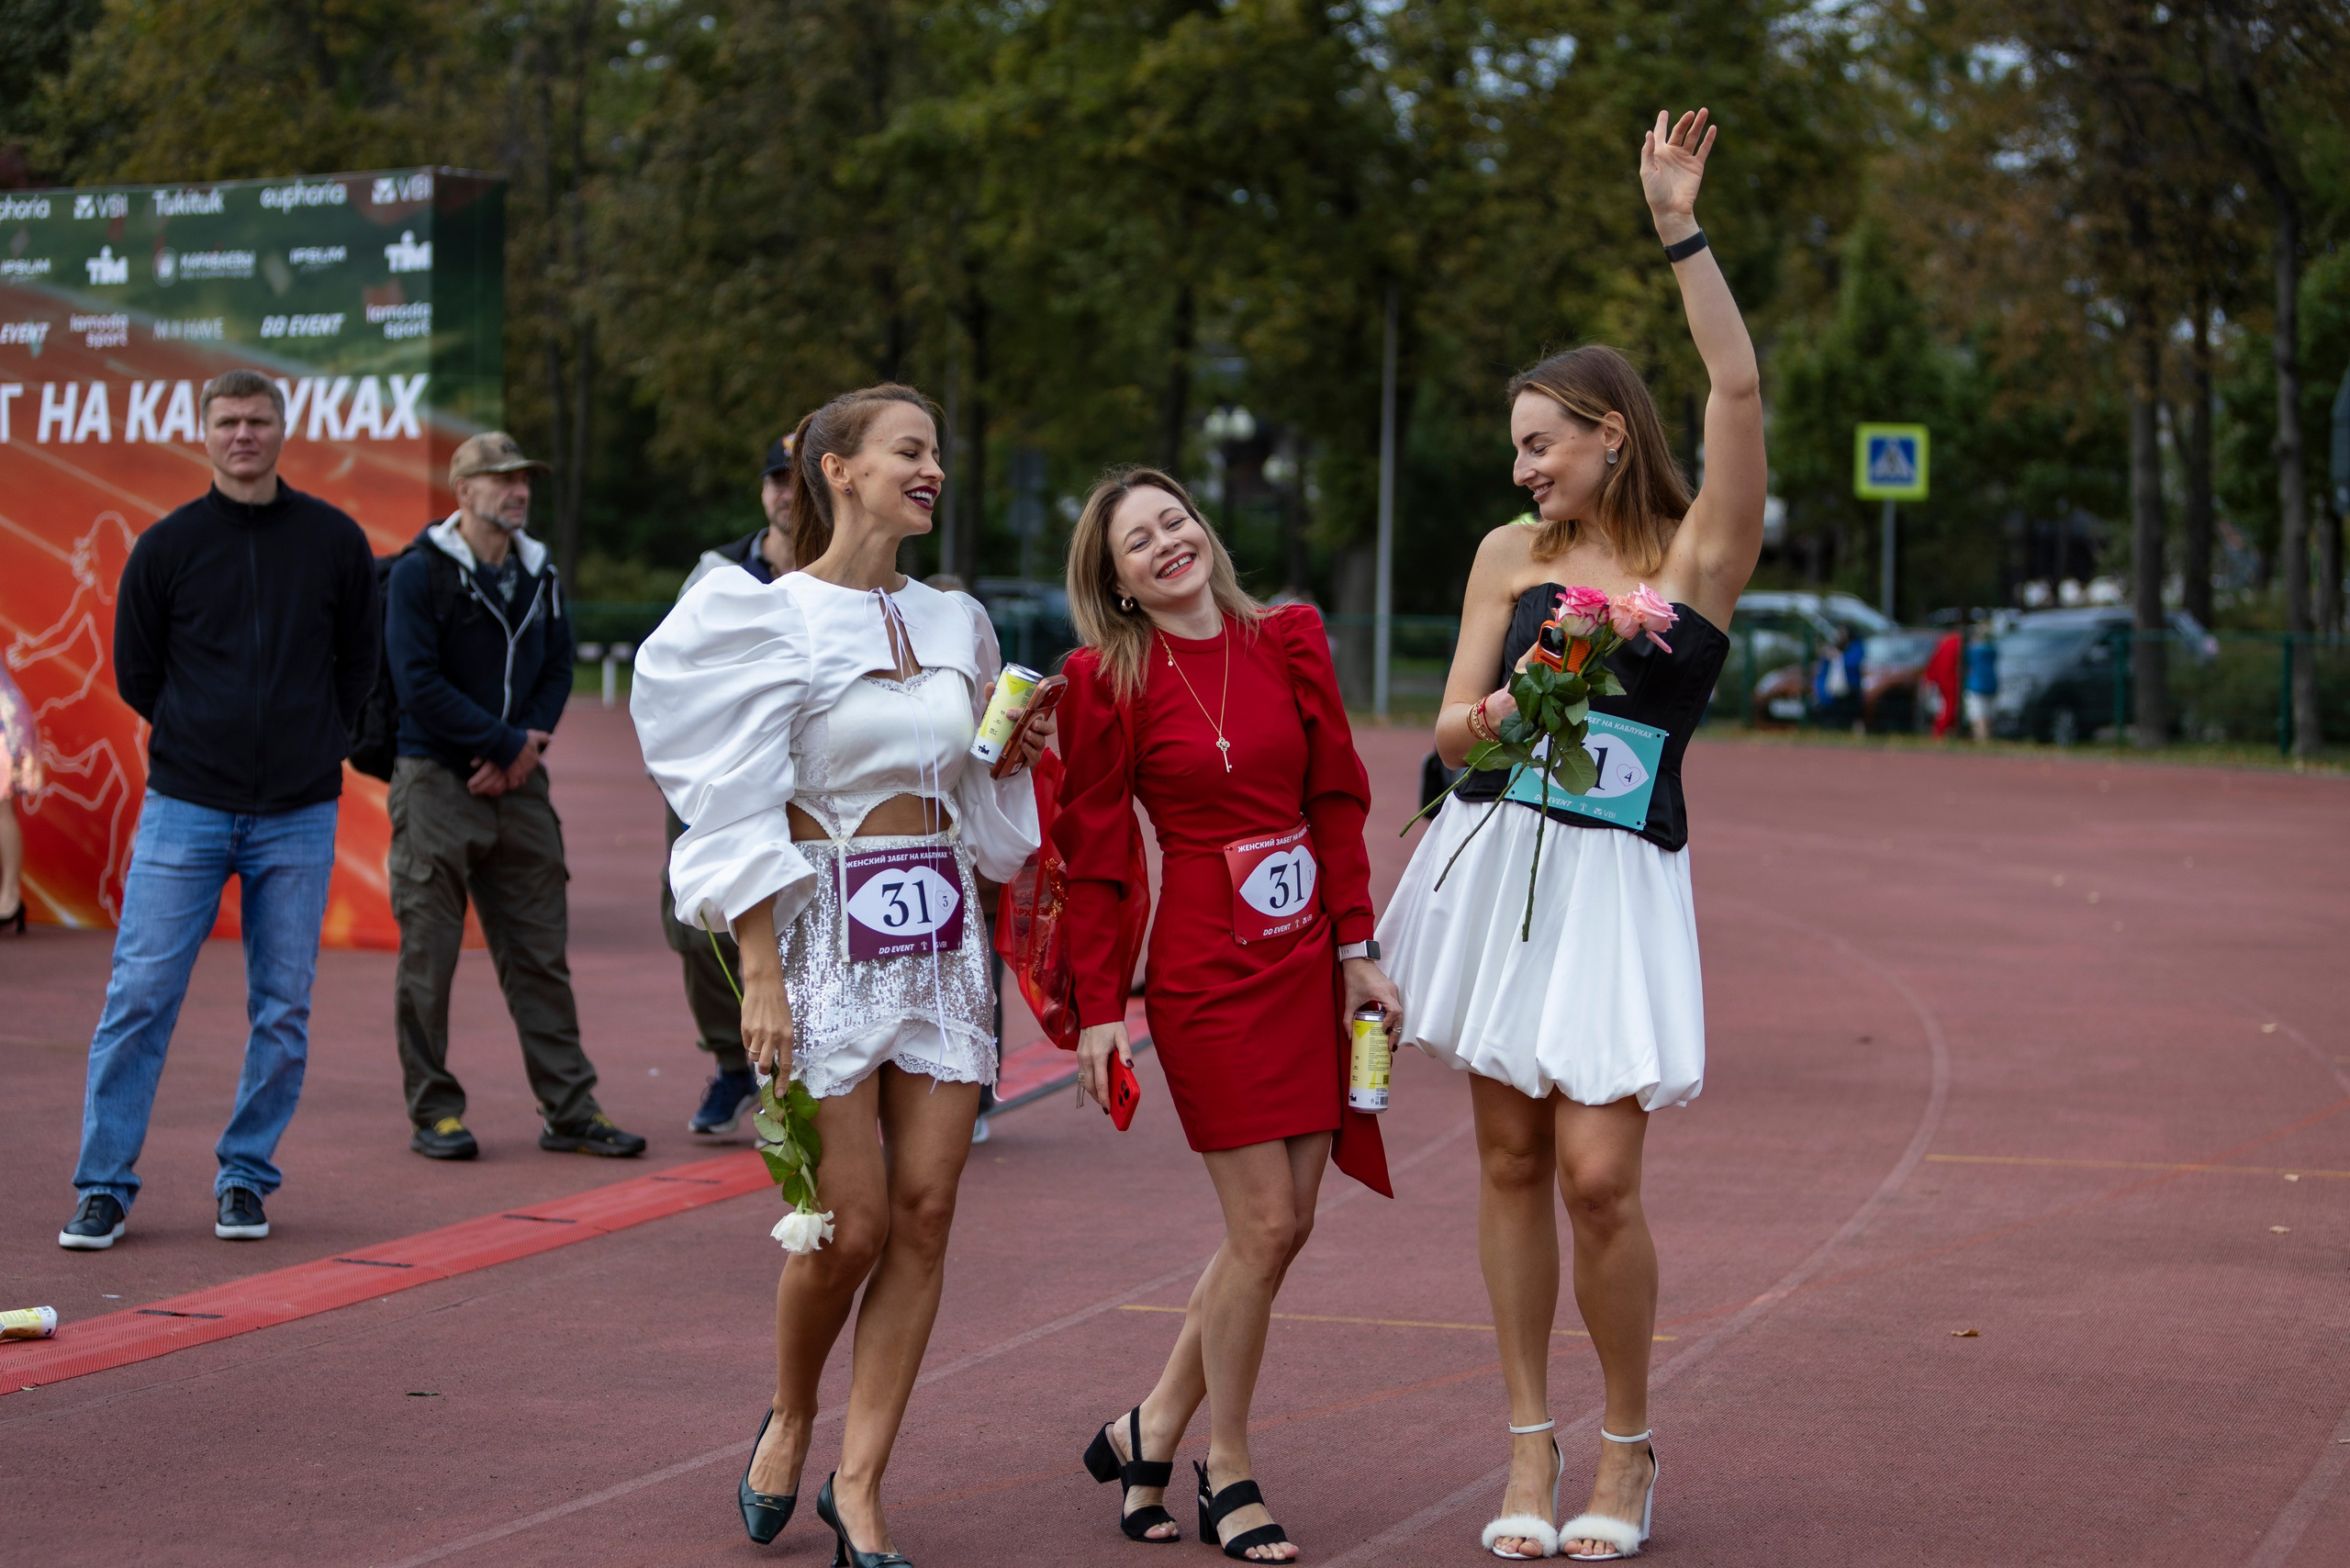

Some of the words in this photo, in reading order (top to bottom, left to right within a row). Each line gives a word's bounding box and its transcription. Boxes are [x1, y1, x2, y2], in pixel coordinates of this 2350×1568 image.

[397, 174, 433, 203] VBI
[70, 312, 129, 332] lamoda
[366, 300, 433, 324] lamoda
[0, 321, 51, 344] EVENT
[288, 312, 346, 338] EVENT
[383, 319, 432, 342] sport
[85, 330, 129, 350] sport
[37, 380, 111, 443] НА
[125, 373, 431, 443] КАУКАХ
[1585, 715, 1602, 724] БЕГ
[1601, 720, 1613, 728] НА
[1614, 723, 1653, 738] КАБЛУКАХ
[1547, 796, 1572, 807] EVENT
[1604, 810, 1617, 819] VBI
[1237, 838, 1275, 853] ЖЕНСКИЙ
[1276, 834, 1292, 846] ЗАБЕГ
[845, 855, 886, 868] ЖЕНСКИЙ
[887, 854, 909, 863] ЗАБЕГ
[1269, 858, 1304, 909] 31
[881, 879, 933, 927] 31
[942, 895, 949, 908] 3
[1263, 928, 1273, 936] DD
[1273, 923, 1291, 934] EVENT
[878, 946, 890, 955] DD
[891, 944, 915, 953] EVENT
